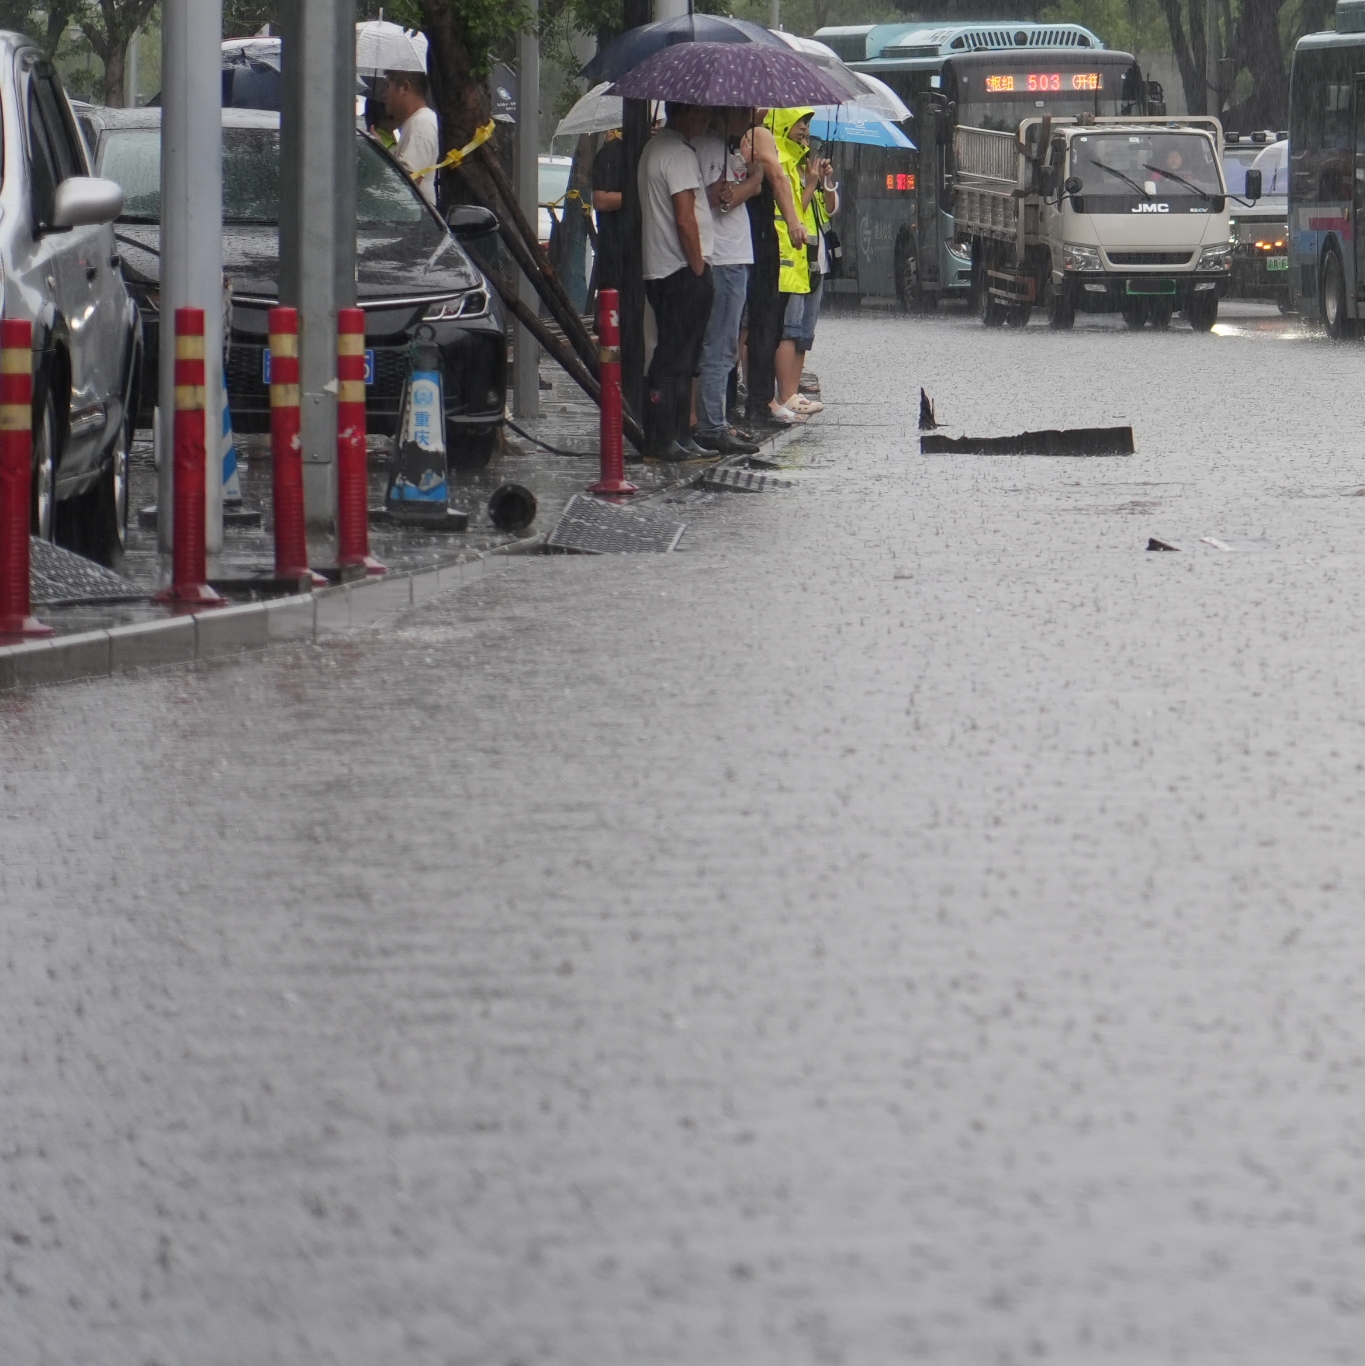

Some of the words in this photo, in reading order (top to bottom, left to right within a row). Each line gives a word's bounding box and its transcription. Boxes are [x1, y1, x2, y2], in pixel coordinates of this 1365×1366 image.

[986, 75, 1015, 92] 枢纽
[1028, 74, 1061, 92] 503
[1131, 203, 1170, 213] JMC
